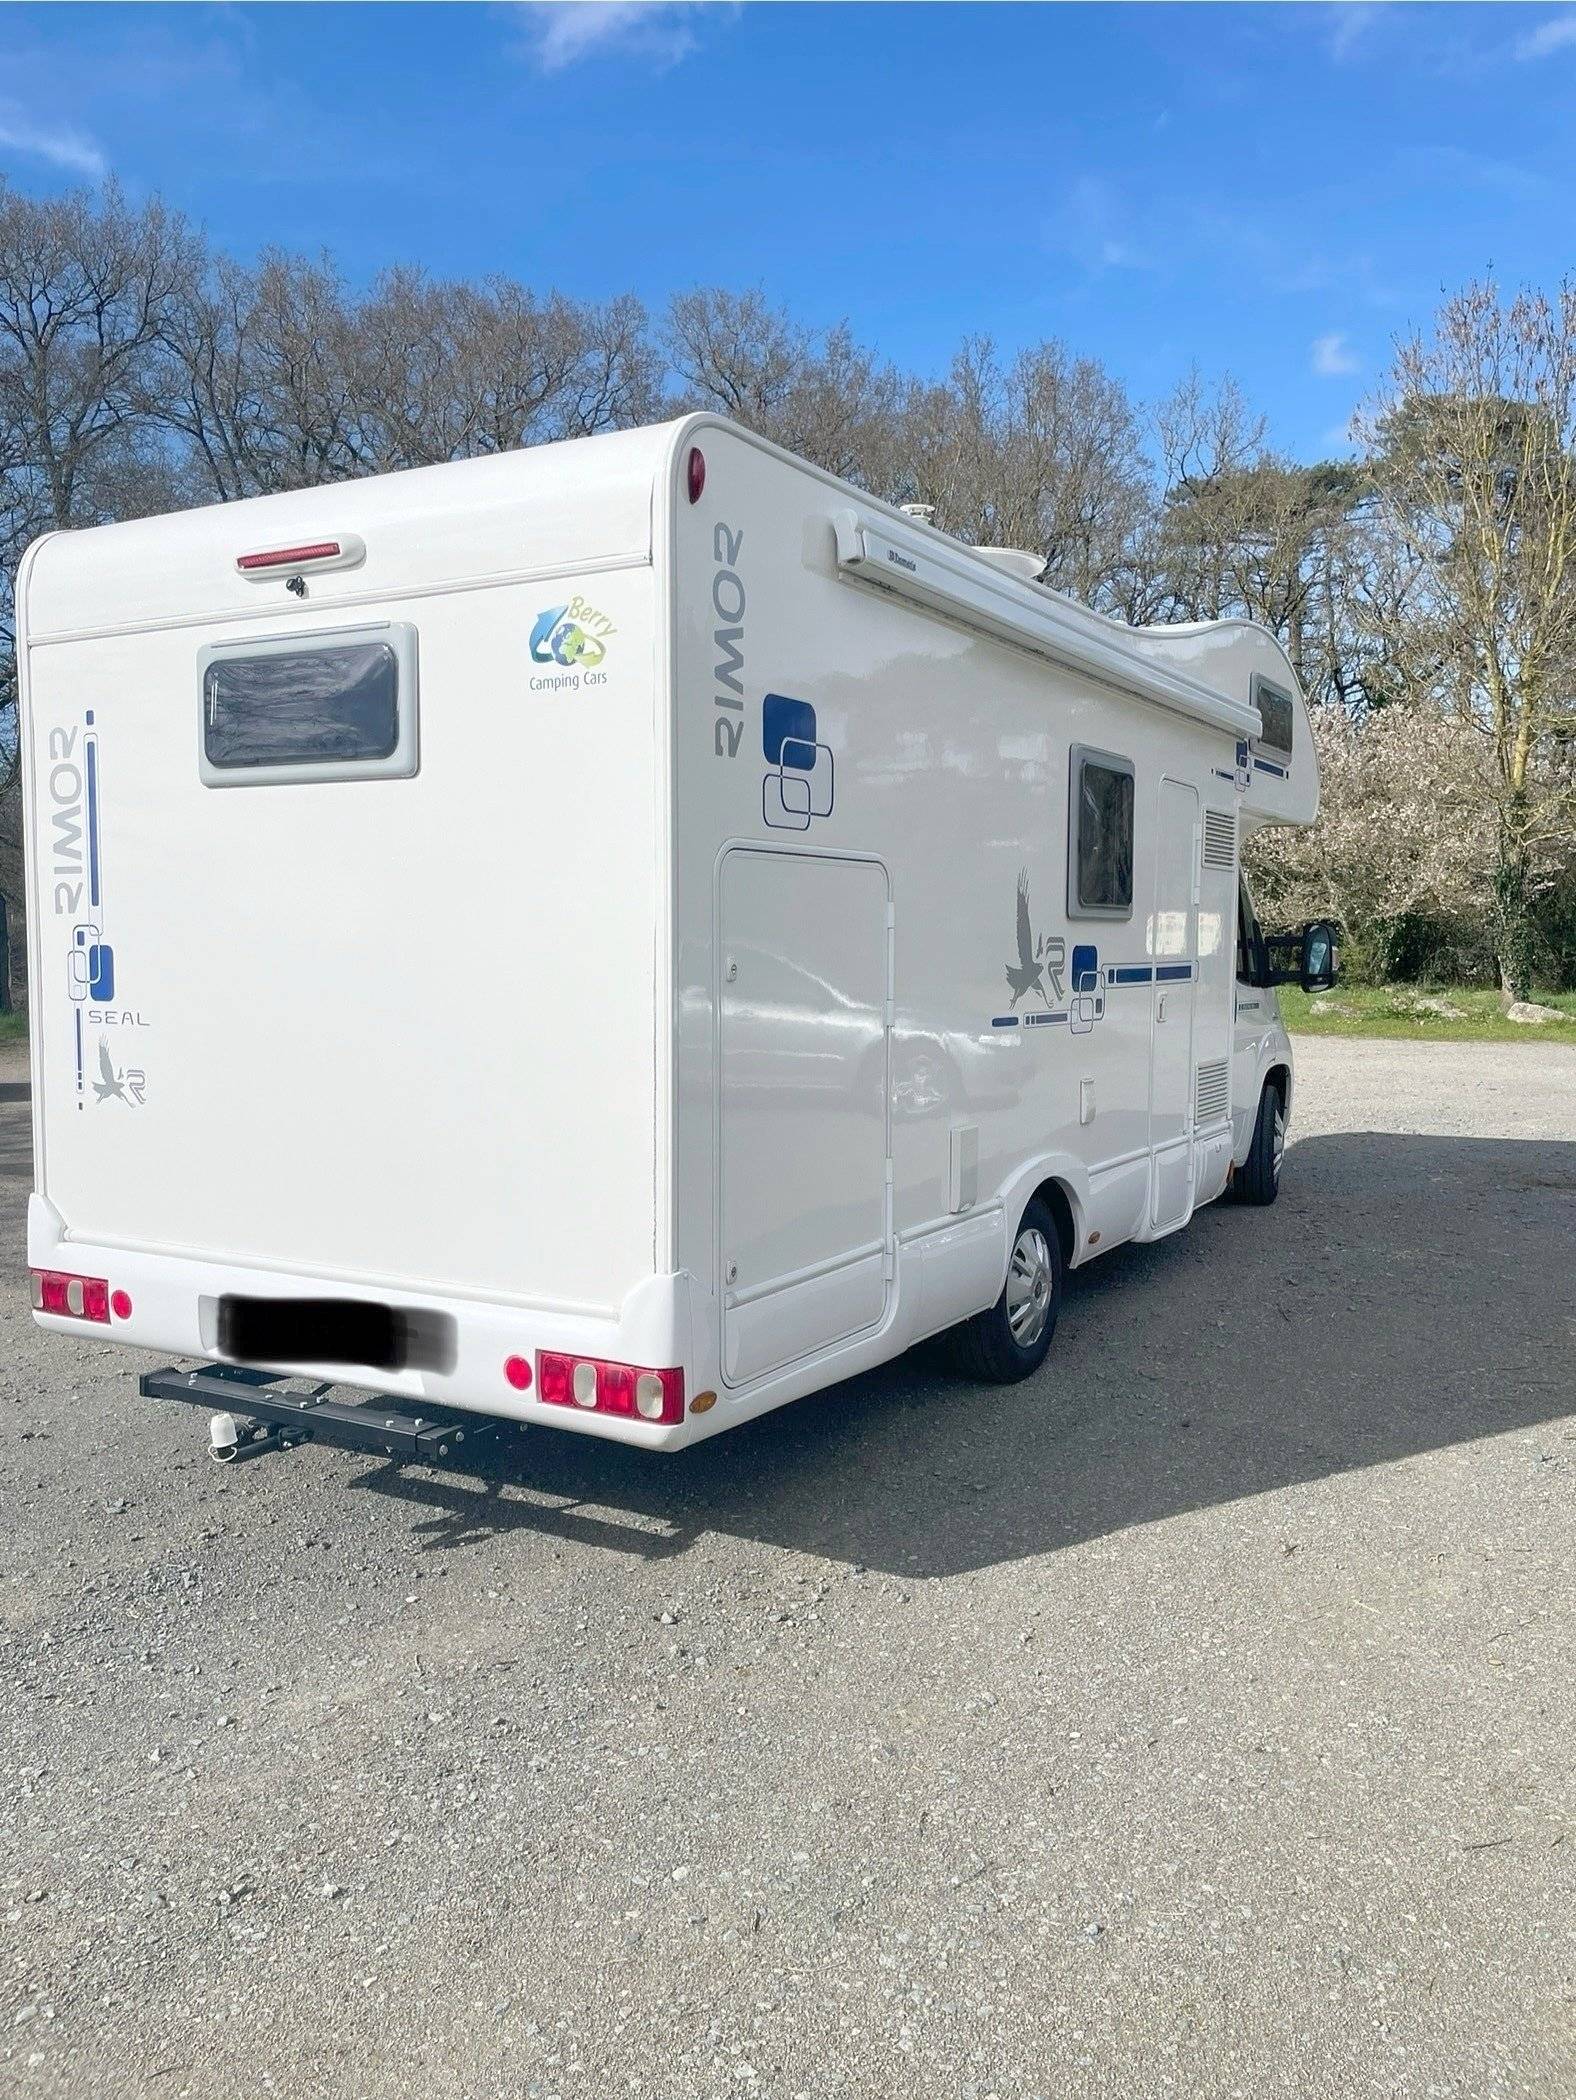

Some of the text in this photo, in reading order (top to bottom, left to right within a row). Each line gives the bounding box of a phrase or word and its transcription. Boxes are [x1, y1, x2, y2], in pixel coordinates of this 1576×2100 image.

[568, 595, 618, 637] Berry
[713, 521, 746, 759] RIMOR
[529, 671, 608, 691] Camping Cars
[49, 725, 84, 915] RIMOR
[88, 1010, 151, 1027] SEAL
